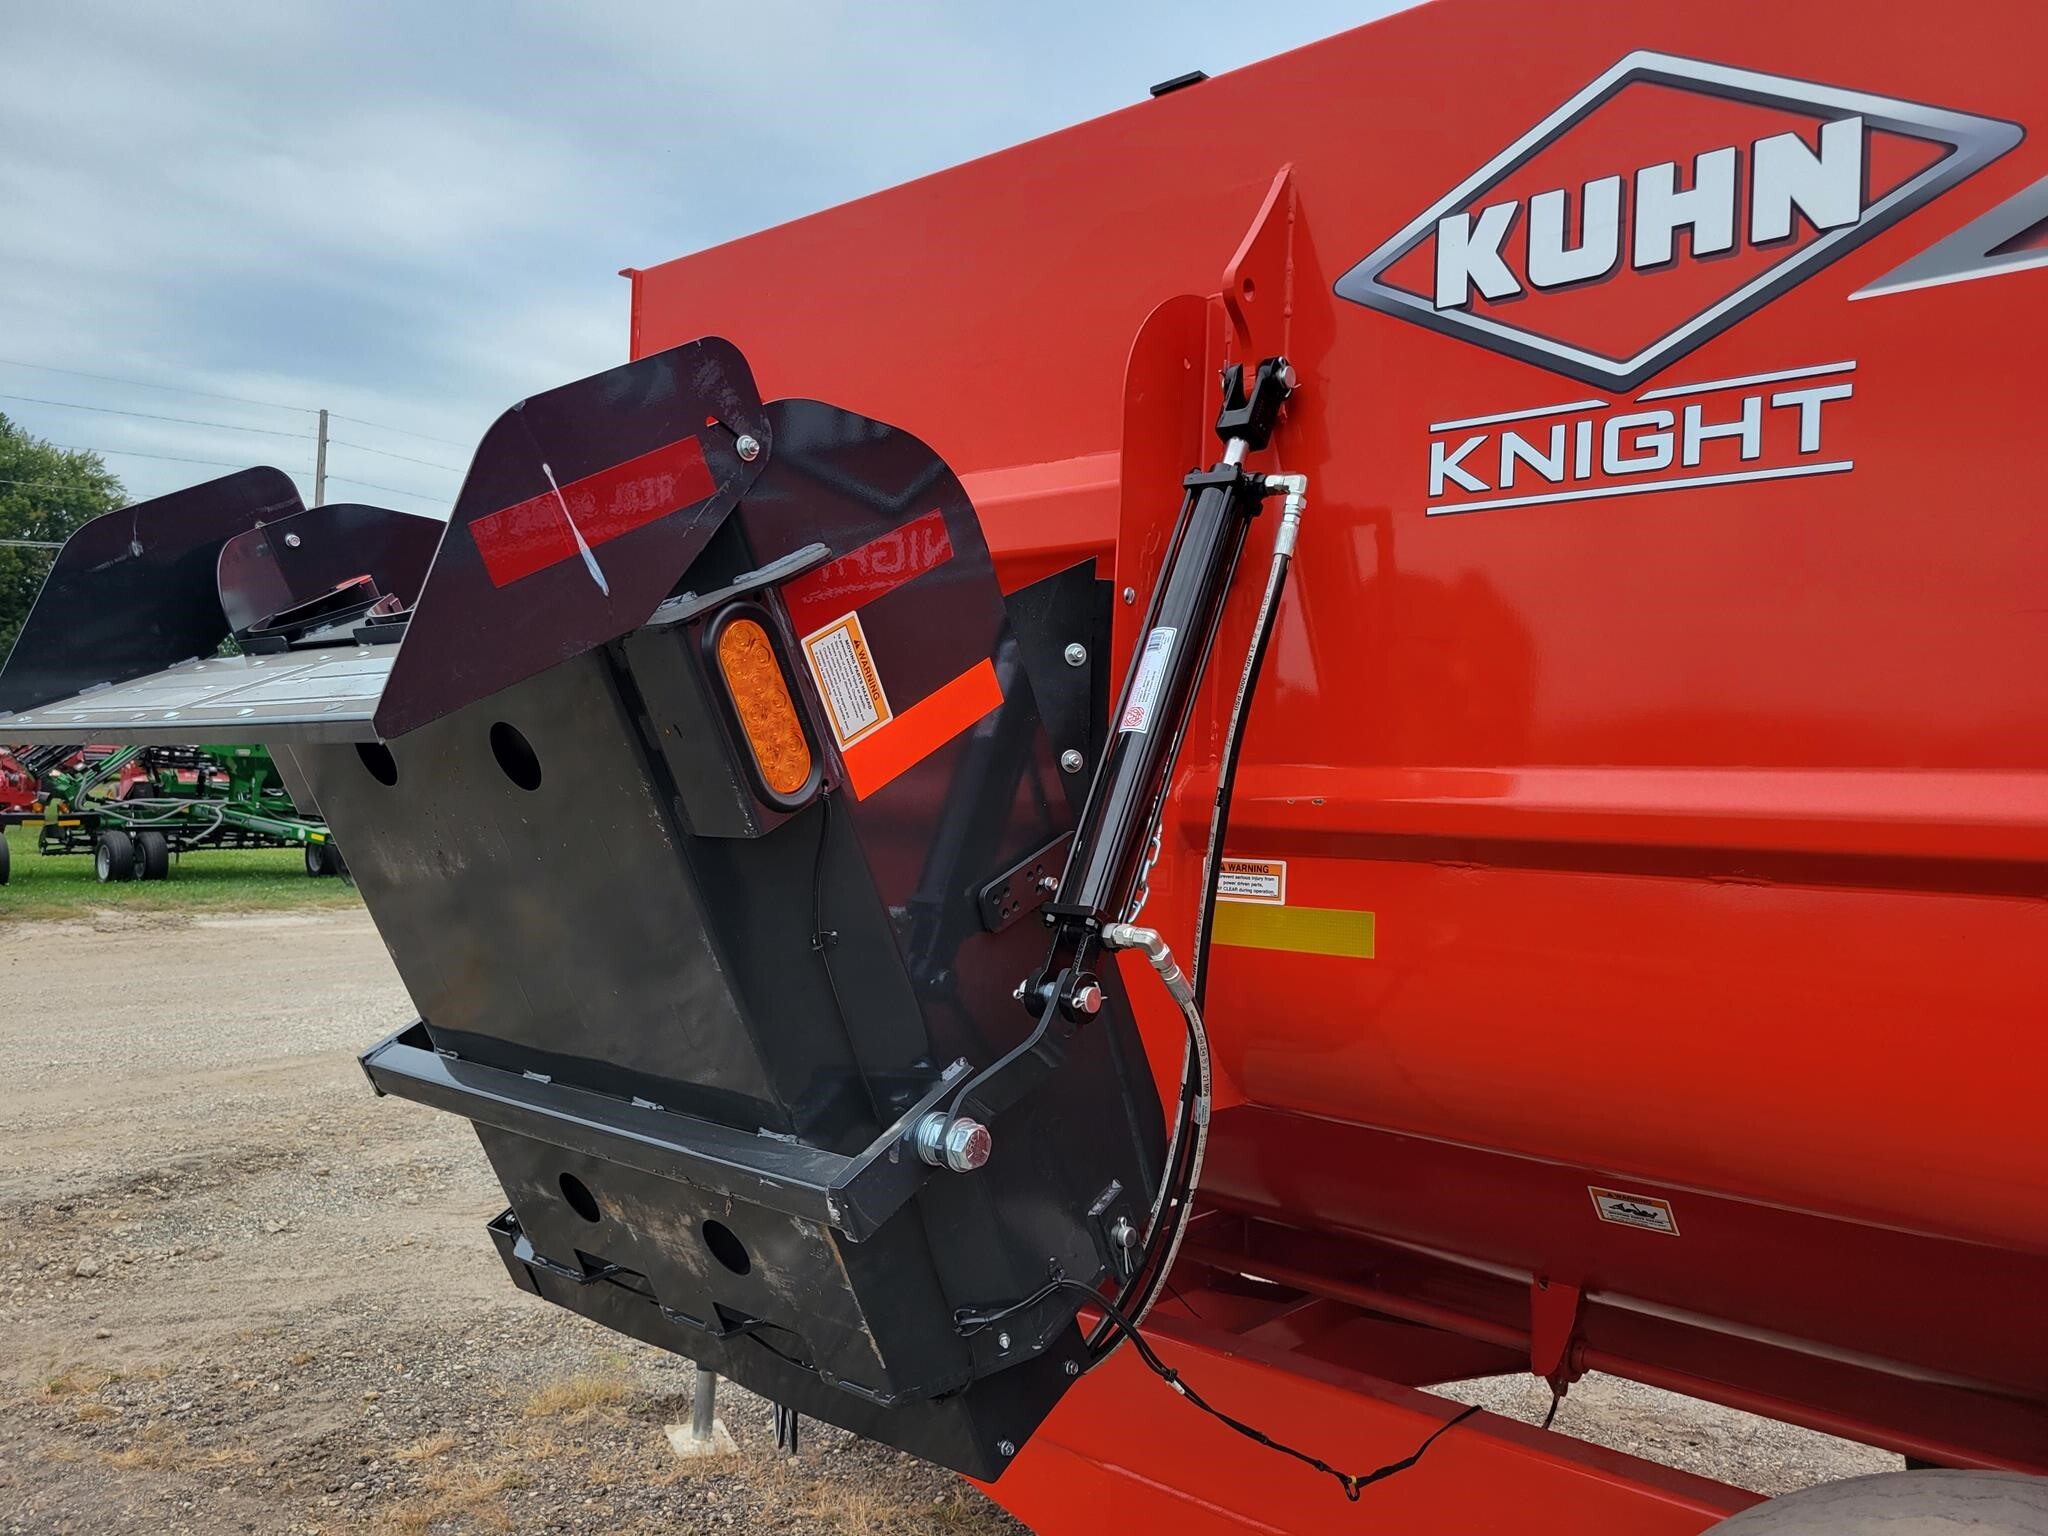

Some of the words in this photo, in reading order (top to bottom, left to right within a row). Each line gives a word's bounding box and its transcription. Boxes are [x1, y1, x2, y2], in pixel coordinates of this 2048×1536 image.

[1434, 115, 1864, 312] KUHN
[1428, 383, 1853, 497] KNIGHT
[844, 639, 856, 664] MOVING
[854, 665, 863, 684] PARTS
[861, 685, 872, 709] HAZARD
[858, 649, 880, 700] WARNING
[1228, 864, 1269, 873] WARNING
